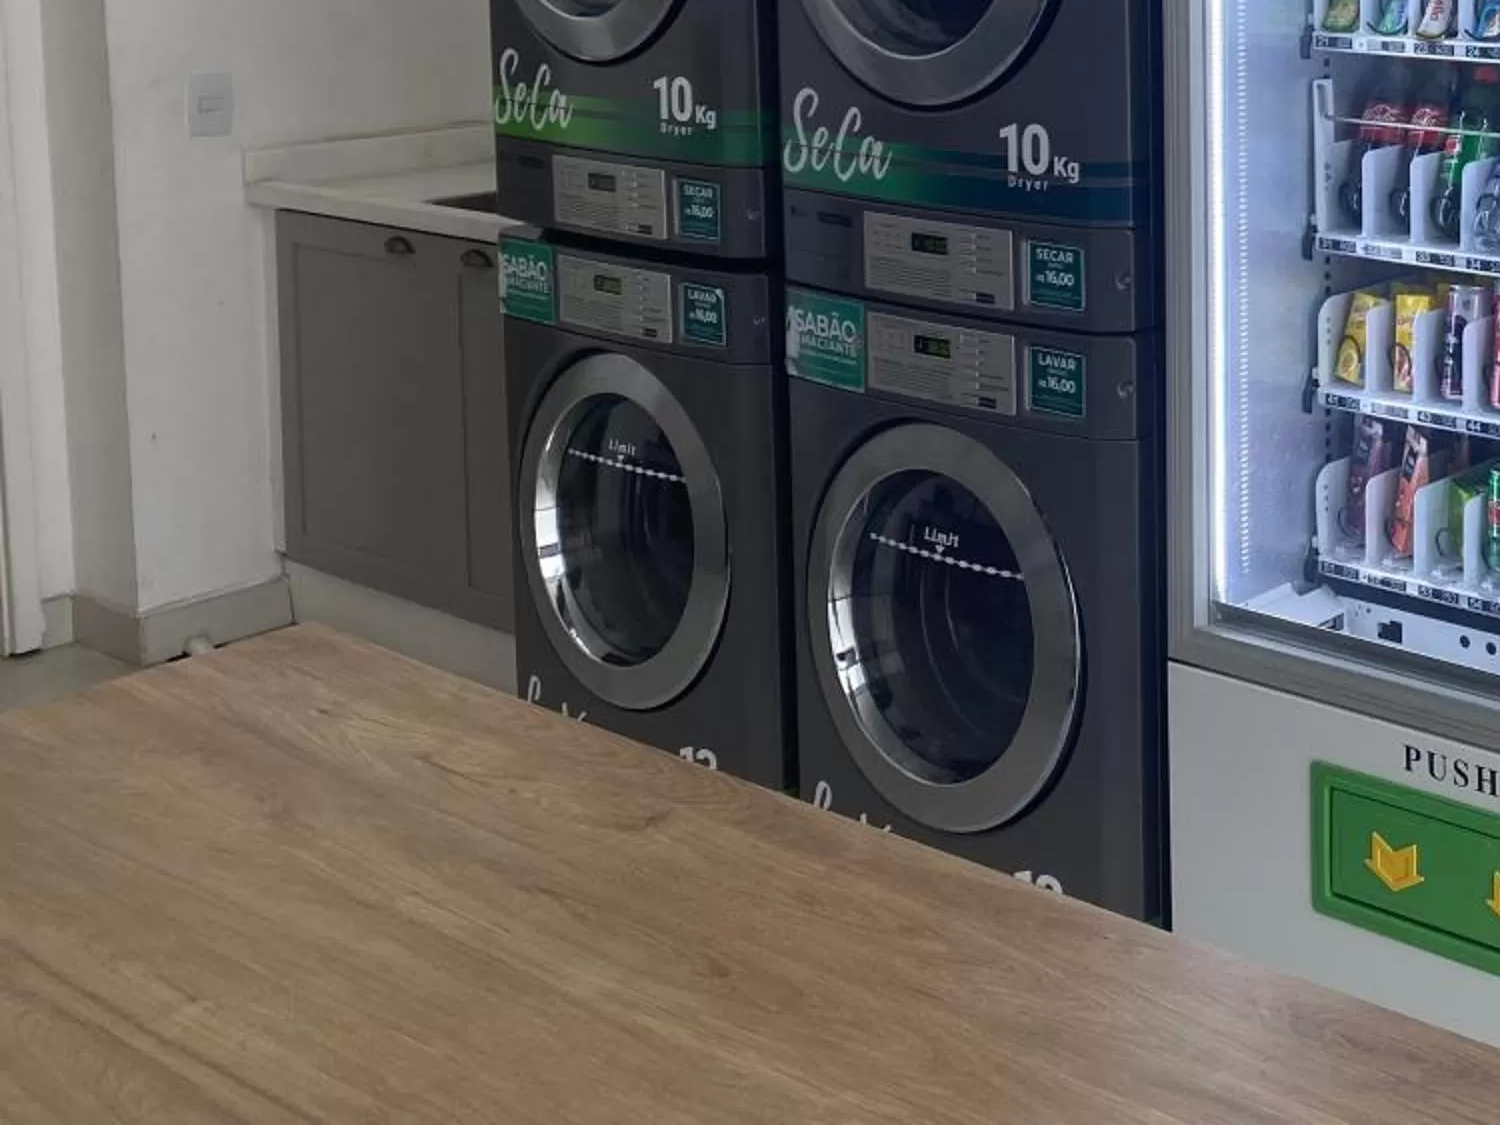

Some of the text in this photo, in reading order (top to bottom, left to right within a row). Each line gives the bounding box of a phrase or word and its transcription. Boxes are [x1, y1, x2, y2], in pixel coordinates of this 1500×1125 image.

[496, 48, 575, 131] SeCa
[653, 76, 718, 130] 10 Kg
[784, 88, 892, 182] SeCa
[1000, 123, 1080, 183] 10 Kg
[1007, 175, 1048, 191] Dryer
[1036, 248, 1073, 263] SECAR
[794, 307, 857, 343] SABÃO
[1037, 352, 1077, 370] LAVAR
[924, 526, 960, 548] Limit
[1404, 744, 1499, 797] PUSH
